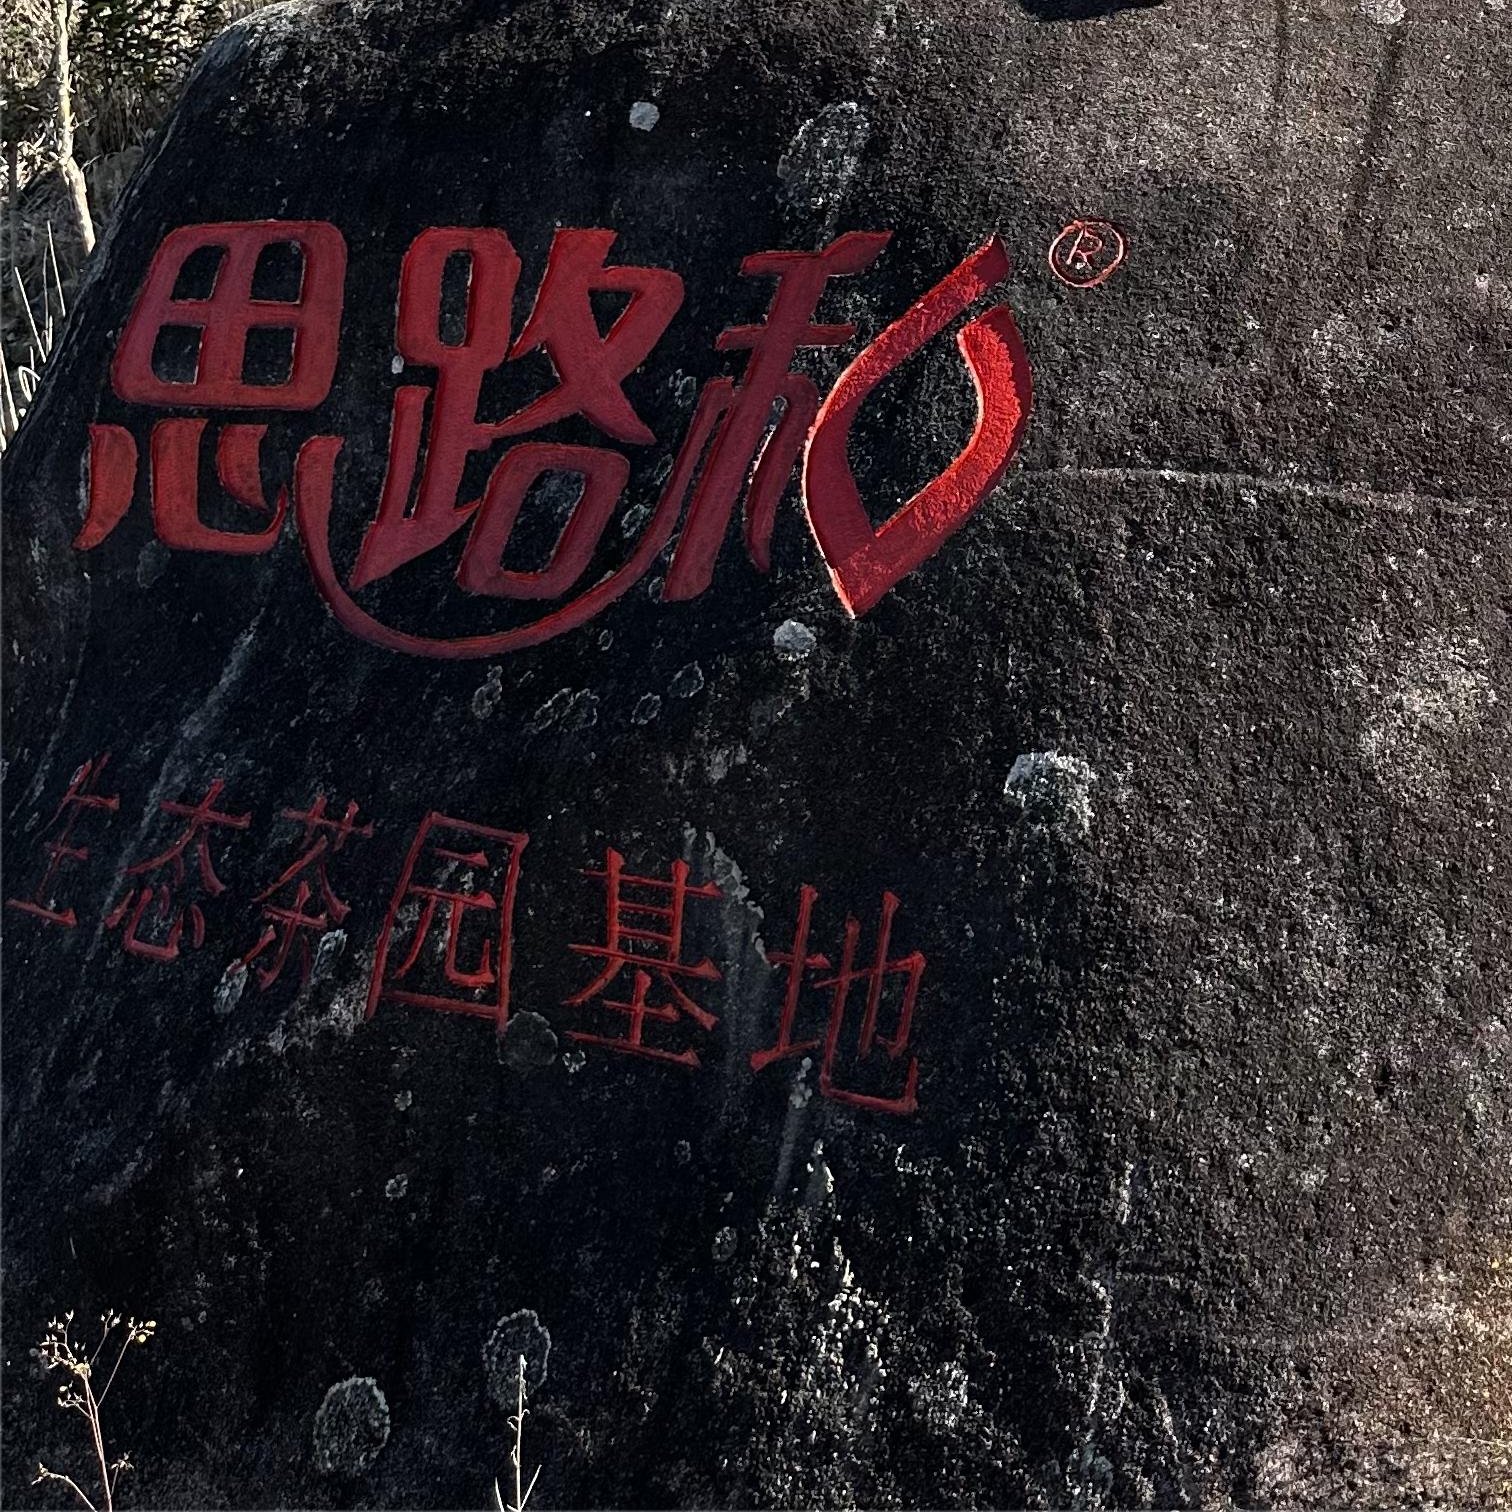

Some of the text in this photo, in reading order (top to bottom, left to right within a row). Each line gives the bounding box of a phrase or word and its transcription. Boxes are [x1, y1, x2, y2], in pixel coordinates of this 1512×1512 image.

[75, 218, 1034, 658] 思路和
[5, 752, 927, 1114] 生态茶园基地
